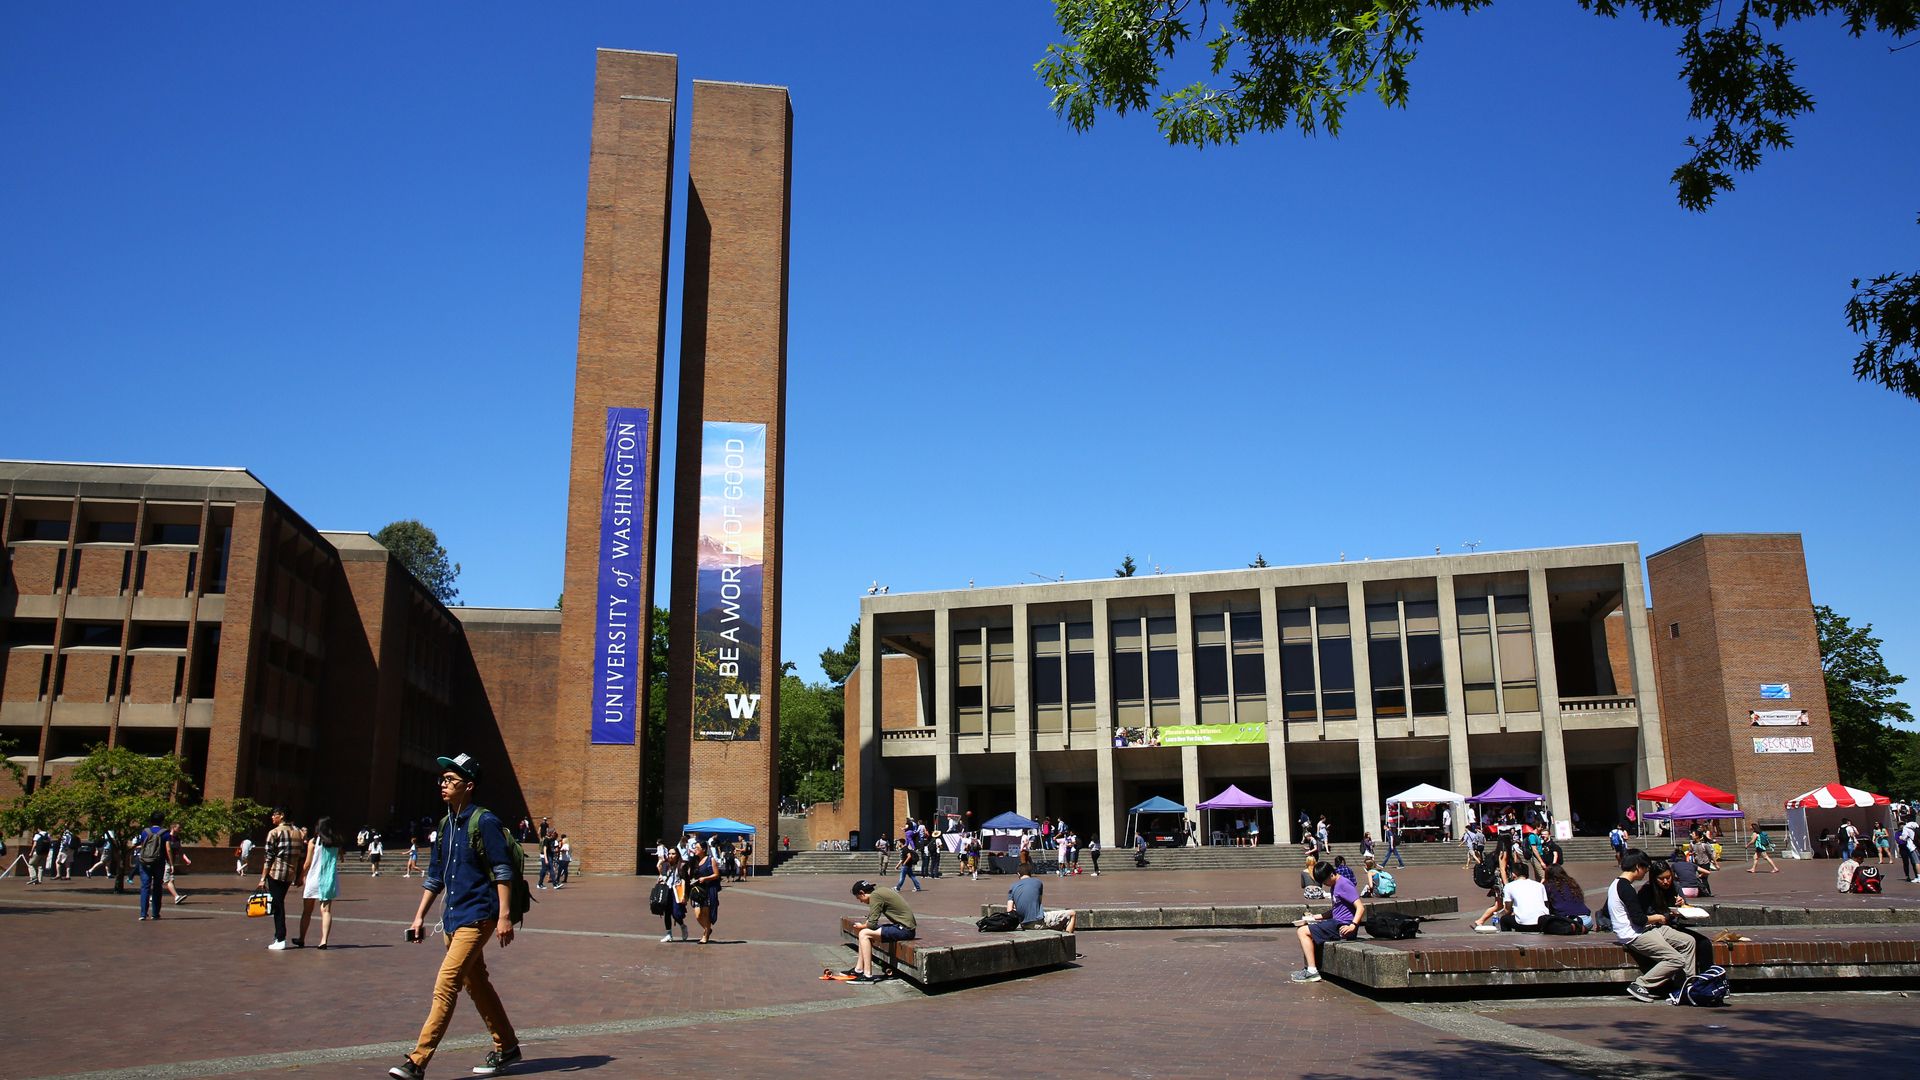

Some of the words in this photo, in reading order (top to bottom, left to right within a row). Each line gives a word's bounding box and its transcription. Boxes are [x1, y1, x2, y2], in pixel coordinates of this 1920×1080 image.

[725, 439, 744, 500] GOOD
[612, 423, 636, 559] WASHINGTON
[723, 505, 742, 535] OF
[612, 567, 633, 588] of
[720, 541, 742, 623] WORLD
[720, 627, 740, 643] A
[605, 594, 628, 723] UNIVERSITY
[719, 647, 740, 677] BE
[724, 693, 761, 719] W
